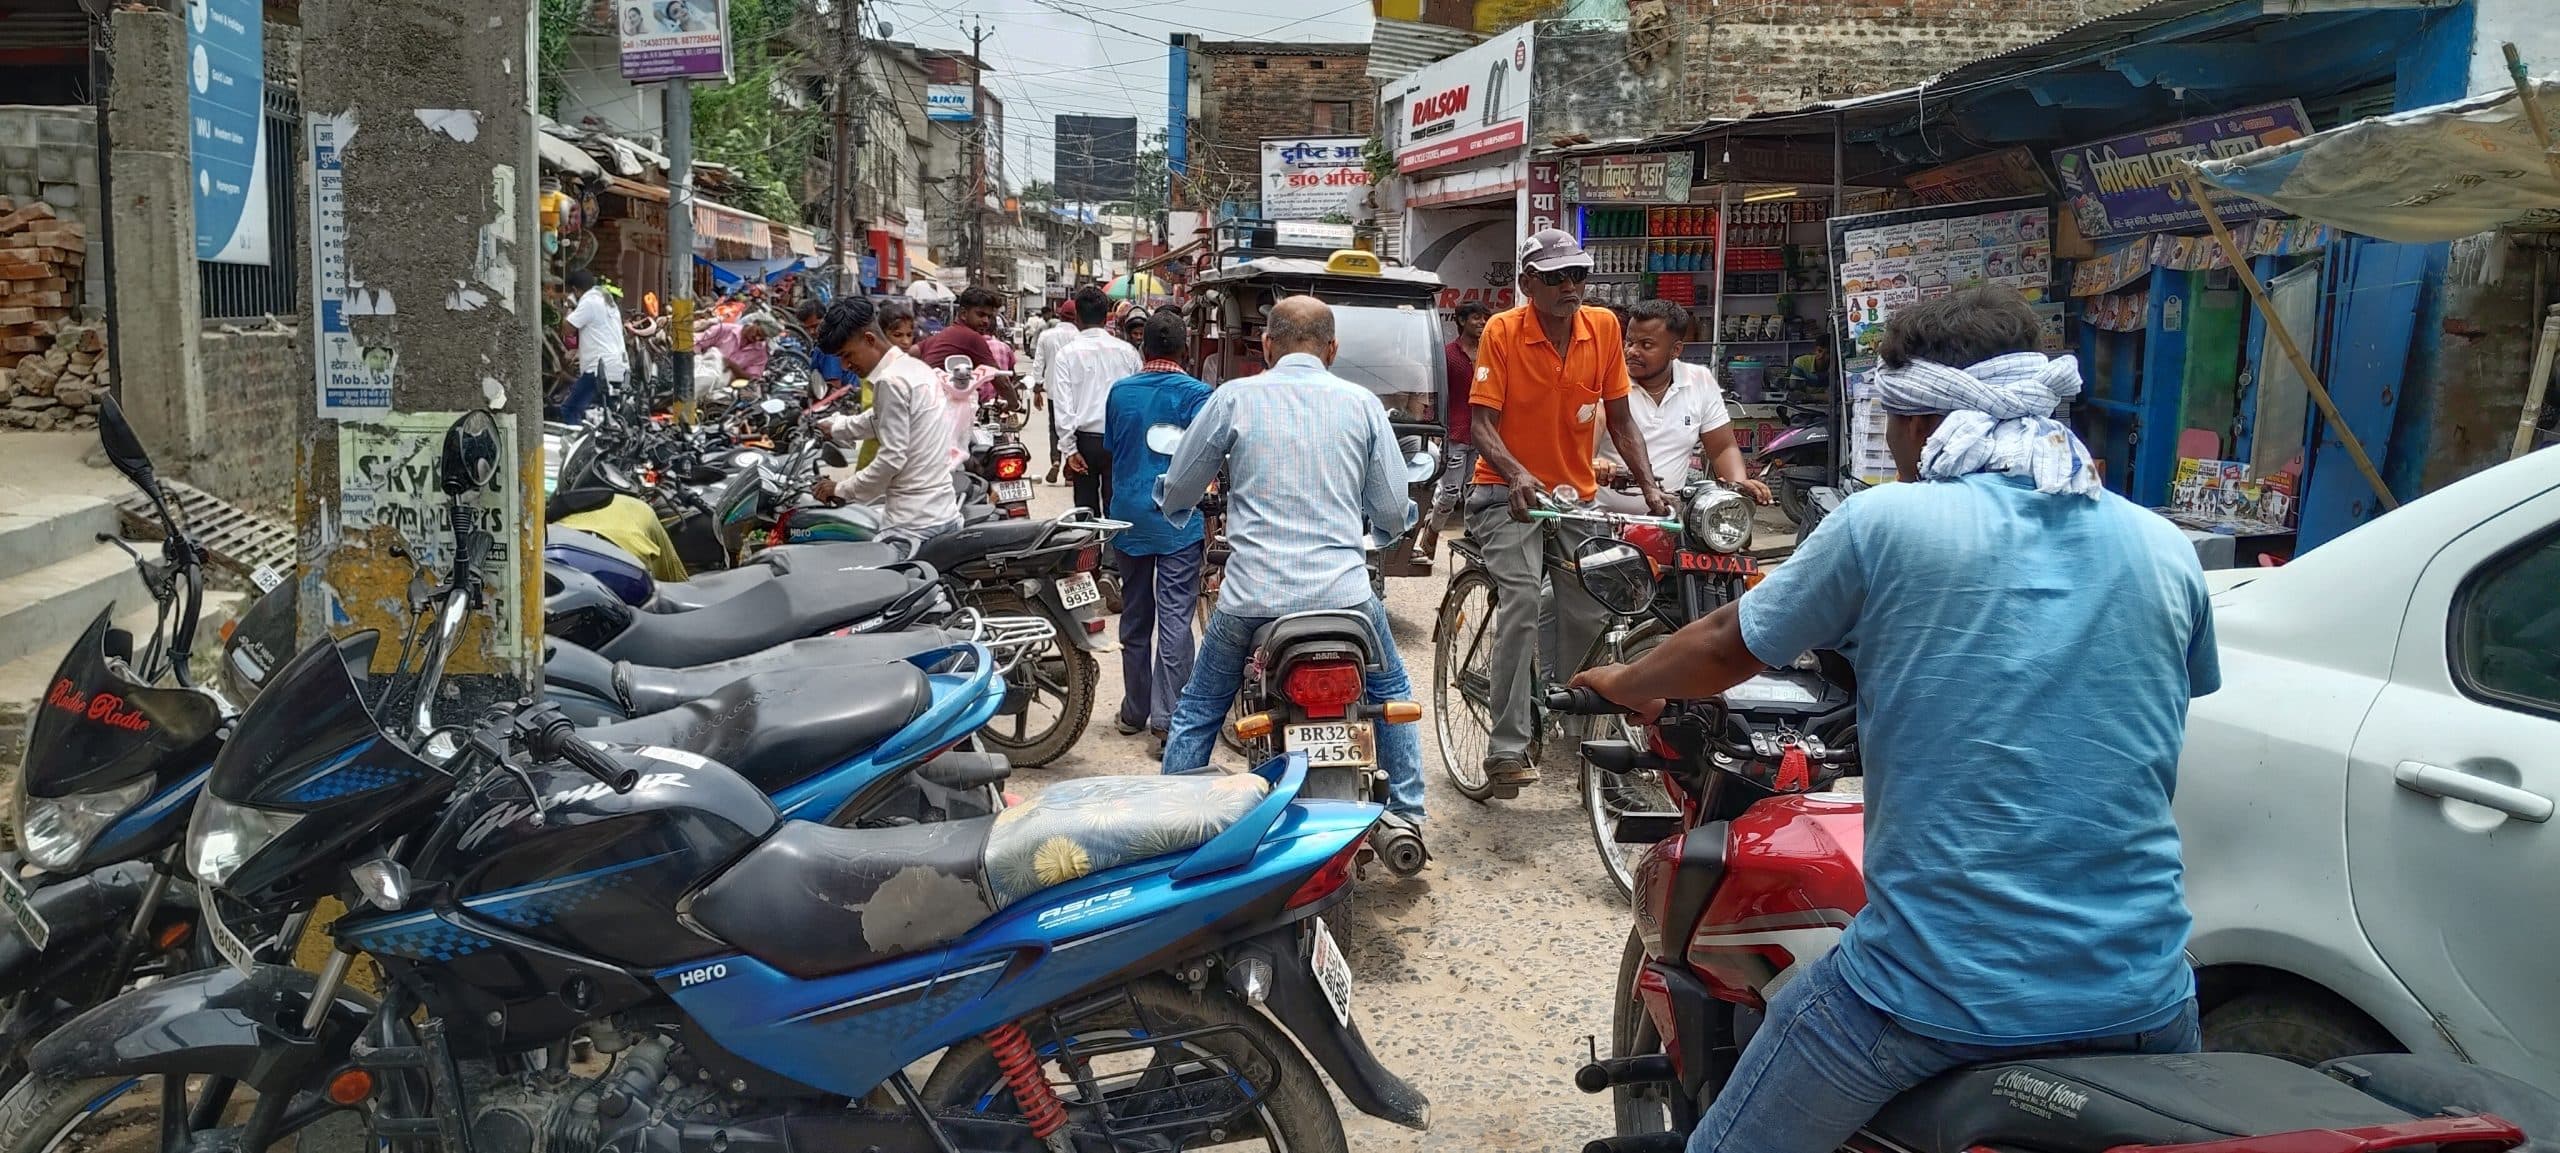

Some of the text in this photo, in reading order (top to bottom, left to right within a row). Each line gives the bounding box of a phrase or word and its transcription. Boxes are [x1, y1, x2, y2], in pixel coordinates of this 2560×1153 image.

[1412, 85, 1470, 127] RALSON
[1581, 166, 1601, 187] गया
[1439, 288, 1514, 309] RALS
[1849, 298, 1861, 312] A
[1868, 308, 1879, 321] B
[332, 375, 369, 386] Mob.:
[1680, 552, 1758, 576] ROYAL
[1066, 591, 1097, 607] 9935
[88, 693, 150, 730] Radhe
[680, 964, 727, 987] Hero
